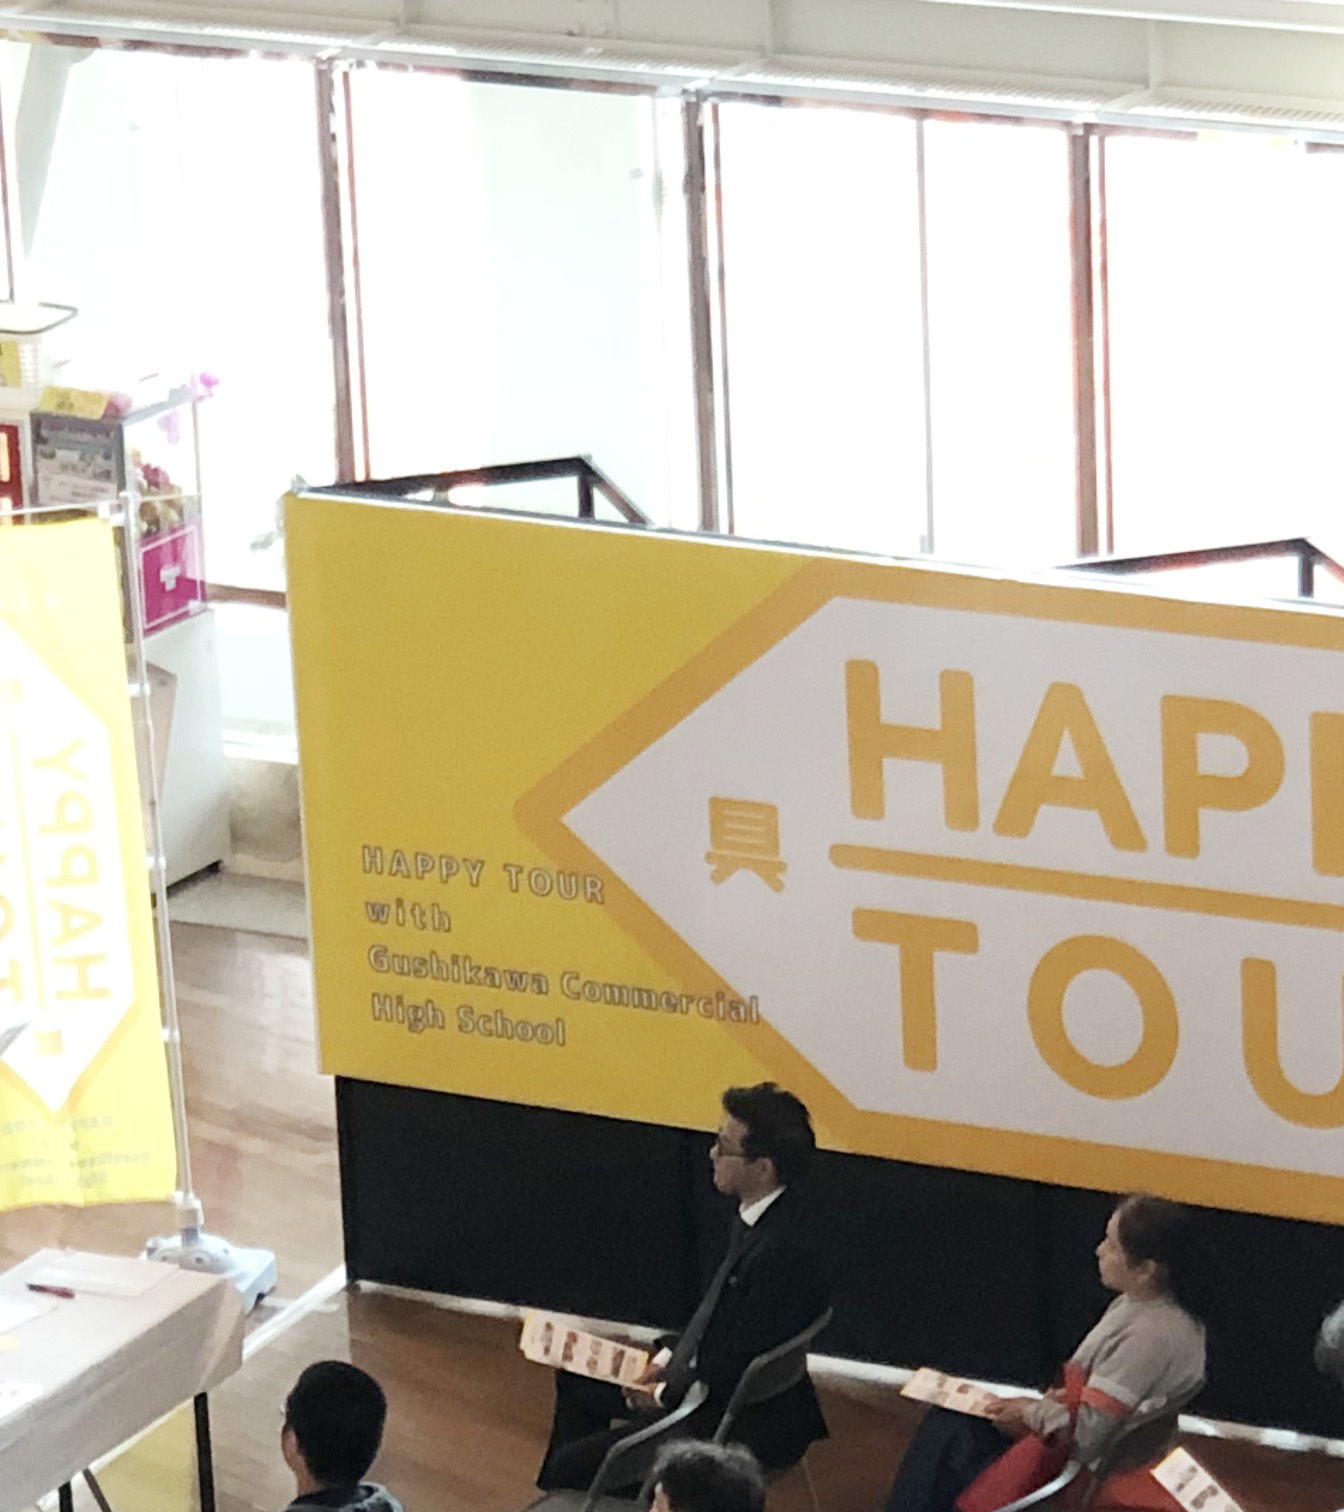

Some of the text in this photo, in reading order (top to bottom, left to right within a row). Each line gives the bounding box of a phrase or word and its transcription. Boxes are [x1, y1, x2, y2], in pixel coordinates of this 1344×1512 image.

[705, 796, 788, 893] 具
[362, 845, 605, 904] HAPPY TOUR
[365, 898, 452, 932] with
[368, 944, 760, 1025] Gushikawa Commercial
[371, 993, 567, 1047] High School
